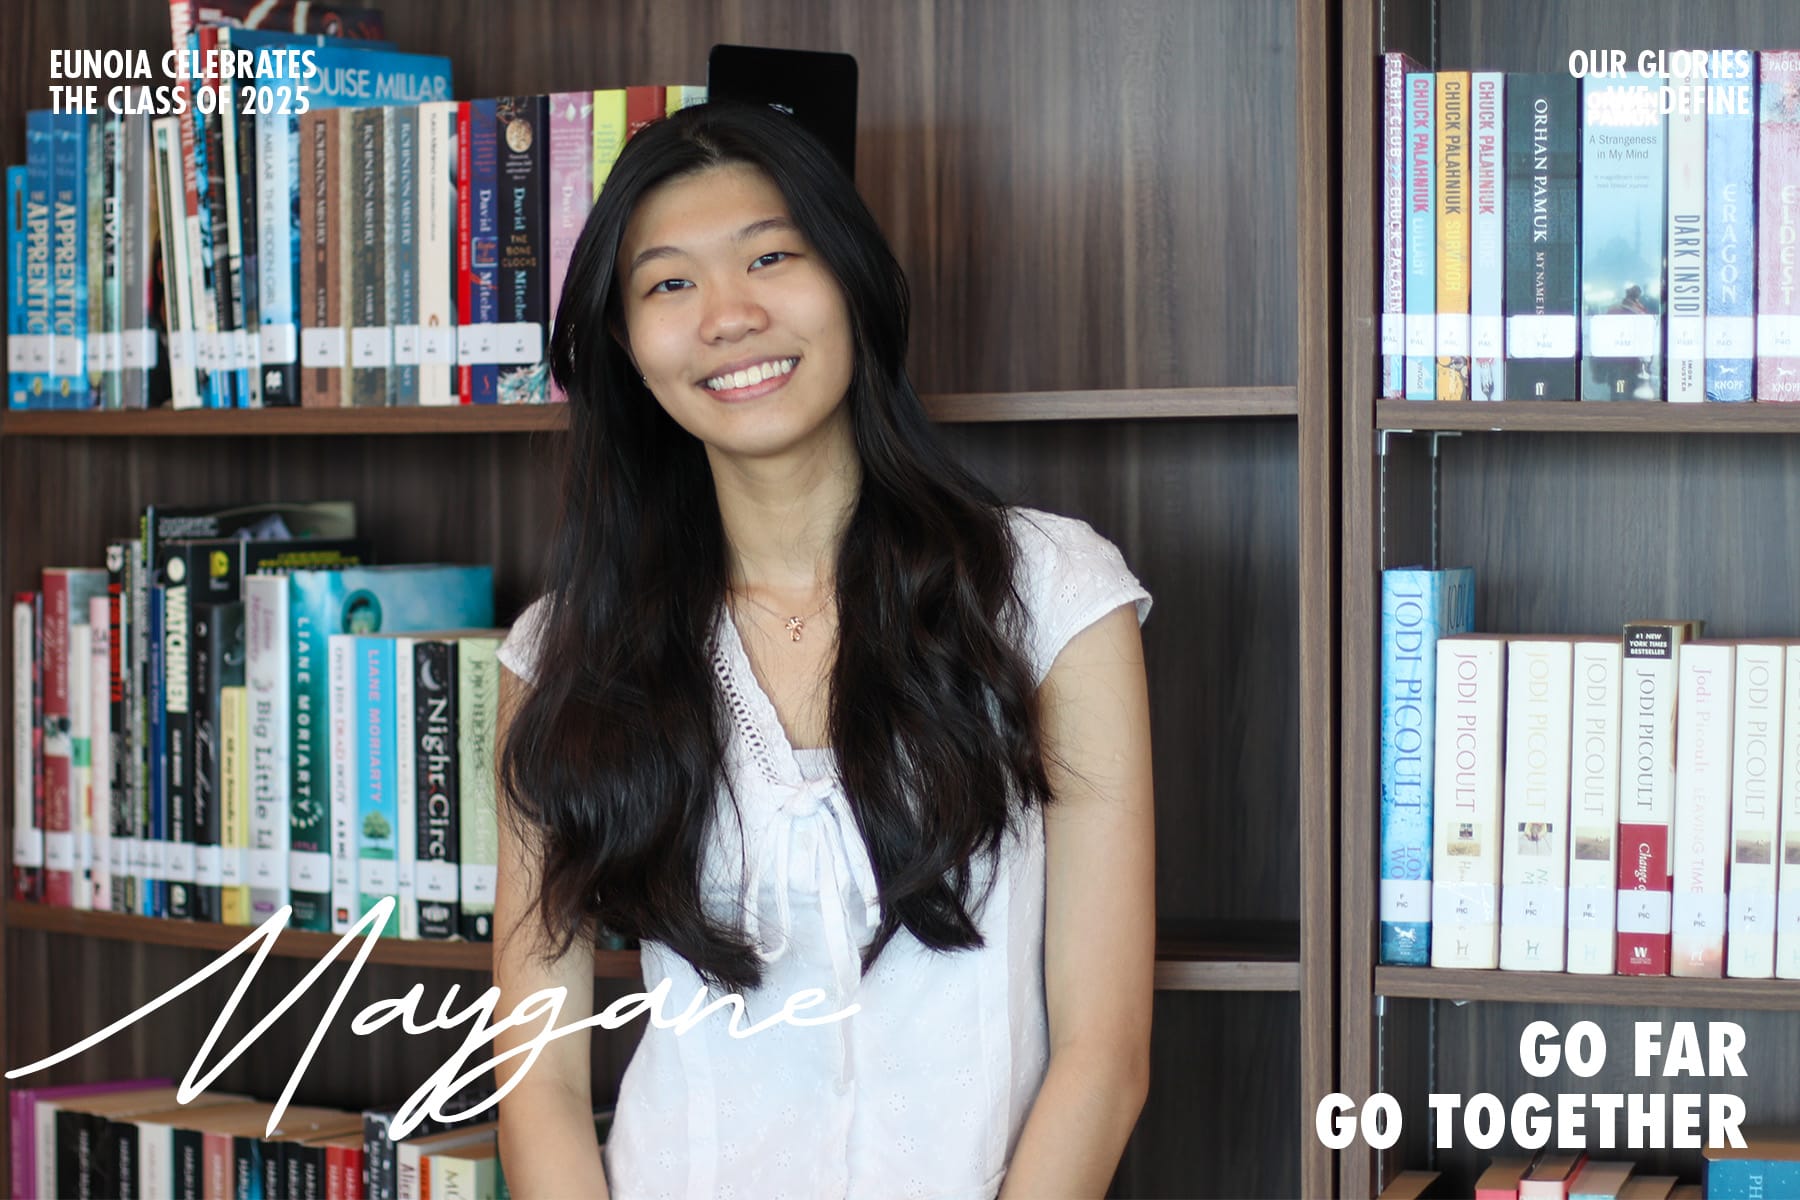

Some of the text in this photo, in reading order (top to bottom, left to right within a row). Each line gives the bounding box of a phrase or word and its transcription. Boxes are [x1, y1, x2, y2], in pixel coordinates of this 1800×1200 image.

[375, 73, 448, 100] MILLAR
[1769, 60, 1800, 72] PAOLI
[1413, 79, 1429, 128] CHUCK
[1479, 82, 1494, 130] CHUCK
[263, 133, 275, 181] MILLAR
[1534, 98, 1548, 170] ORHAN
[1589, 134, 1657, 148] A Strangeness
[1597, 149, 1649, 162] in My Mind
[1389, 58, 1402, 313] FIGHT CLUB CHUCK PALAHN
[1413, 133, 1429, 213] PALAHNIUK
[1445, 82, 1461, 291] CHUCK PALAHNIUK SURVIVOR
[1479, 136, 1494, 215] PALAHNIUK
[479, 189, 492, 232] David
[513, 187, 527, 231] David
[560, 185, 574, 229] David
[1533, 176, 1548, 243] PAMUK
[1674, 215, 1700, 257] DARK
[27, 202, 49, 335] APPRENTIC
[54, 202, 77, 335] APPRENTIC
[1536, 272, 1545, 302] NAME
[1674, 266, 1700, 317] INSID
[479, 271, 493, 323] Mitche
[513, 270, 528, 323] Mitche
[1714, 380, 1745, 391] KNOPF
[165, 585, 190, 714] WATCHMEN
[1629, 640, 1648, 648] YORK
[1630, 648, 1665, 656] BESTSELLER
[1392, 591, 1423, 814] JODI PICOULT
[1692, 665, 1712, 703] Jodi
[297, 617, 311, 813] LIANE MORIARTY
[367, 649, 382, 803] LIANE MORIARTY
[1454, 652, 1477, 812] JODI PICOULT
[1526, 652, 1549, 811] JODI PICOULT
[1584, 656, 1607, 816] JODI PICOULT
[1636, 670, 1655, 811] JODI PICOULT
[1744, 657, 1769, 819] JODI PICOULT
[253, 700, 274, 850] Big Little Li
[421, 696, 450, 861] Night Circ
[1391, 849, 1406, 880] WO
[1634, 843, 1653, 885] Change
